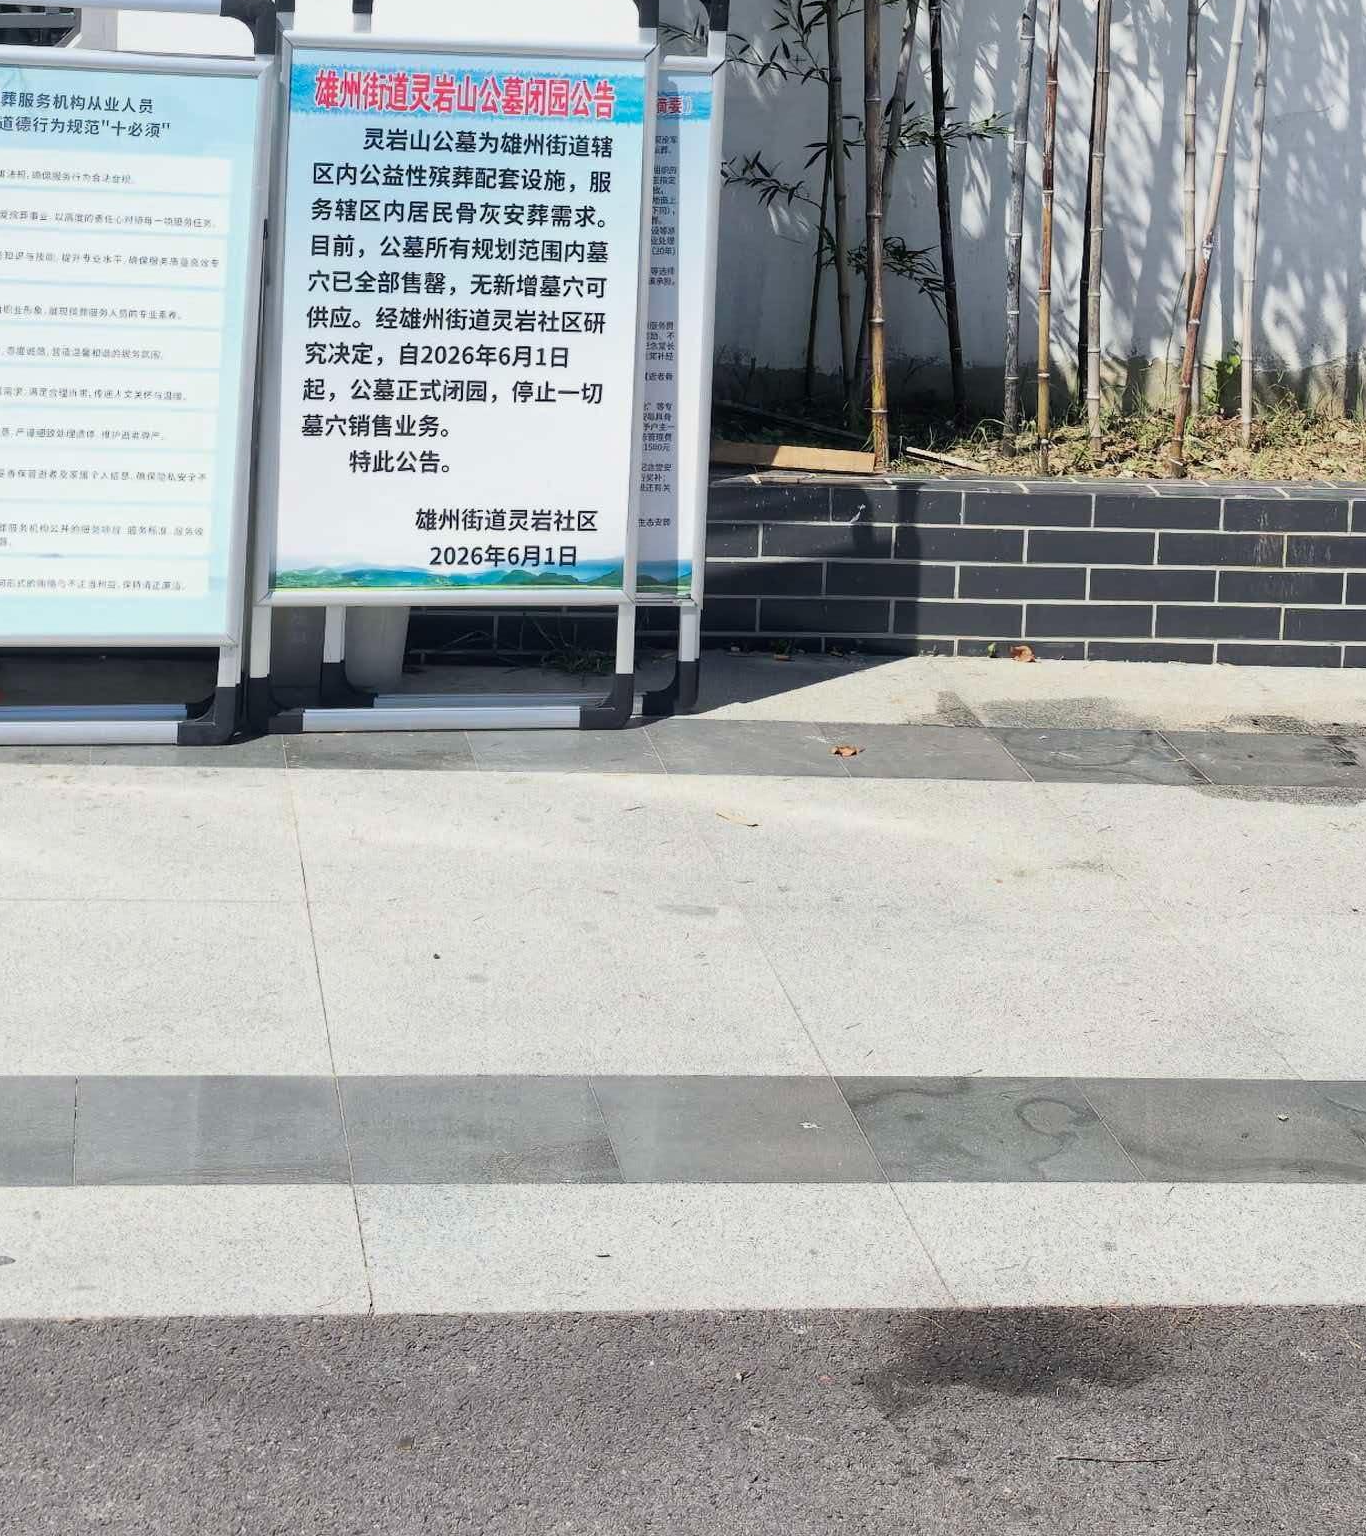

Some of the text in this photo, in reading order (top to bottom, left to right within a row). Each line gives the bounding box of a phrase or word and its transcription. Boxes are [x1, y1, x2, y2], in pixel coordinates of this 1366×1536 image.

[315, 68, 616, 119] 雄州街道灵岩山公墓闭园公告
[364, 128, 613, 158] 灵岩山公墓为雄州街道辖
[313, 162, 611, 194] 区内公益性殡葬配套设施，服
[311, 198, 607, 228] 务辖区内居民骨灰安葬需求。
[311, 235, 609, 263] 目前，公墓所有规划范围内墓
[307, 270, 607, 299] 穴已全部售罄，无新增墓穴可
[306, 306, 606, 334] 供应。经雄州街道灵岩社区研
[304, 343, 569, 369] 究决定，自2026年6月1日
[302, 378, 603, 405] 起，公墓正式闭园，停止一切
[301, 414, 450, 439] 墓穴销售业务。
[349, 450, 451, 474] 特此公告。
[415, 508, 598, 532] 雄州街道灵岩社区
[429, 545, 577, 567] 2026年6月1日
